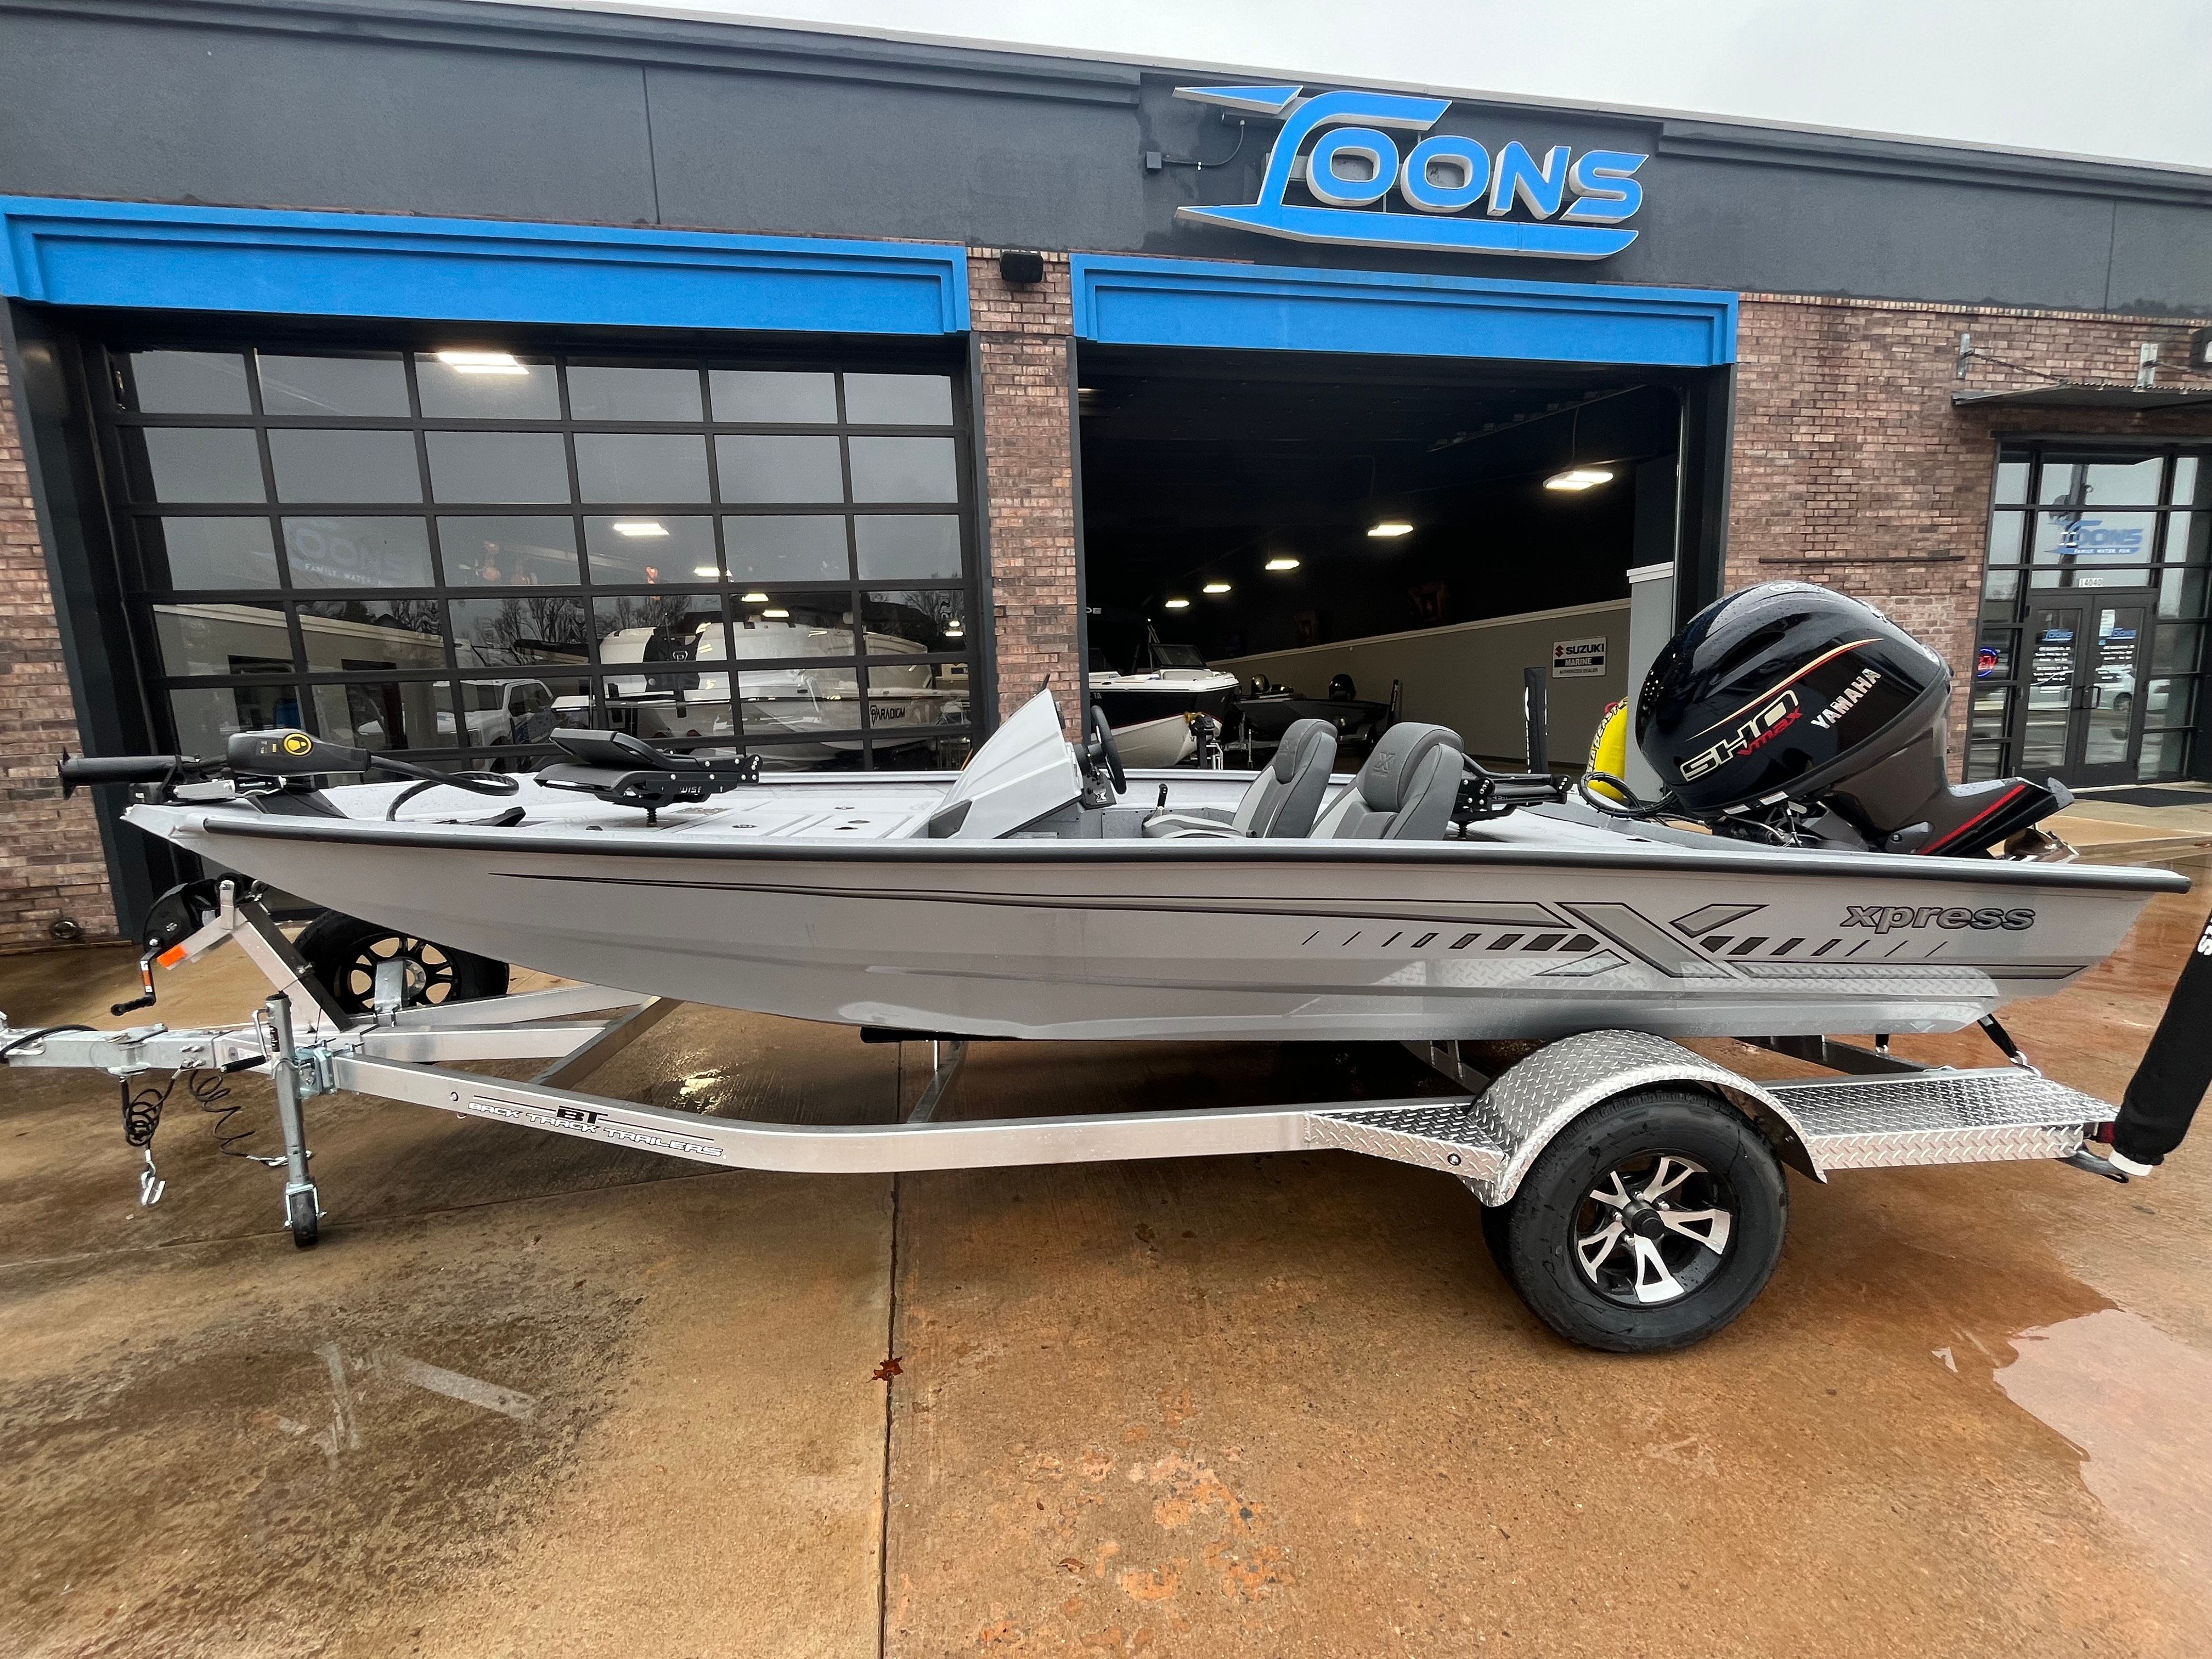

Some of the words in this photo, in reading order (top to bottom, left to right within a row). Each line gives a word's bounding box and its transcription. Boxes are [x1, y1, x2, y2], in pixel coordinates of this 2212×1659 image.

[1565, 658, 1592, 666] MARINE
[1566, 644, 1604, 655] SUZUKI
[1810, 668, 1881, 729] YAMAHA
[870, 705, 905, 726] PARADIGM
[1680, 690, 1799, 782] SHO
[1839, 905, 2036, 934] xpress
[556, 1105, 608, 1124] BT
[469, 1102, 523, 1118] BACK
[526, 1113, 601, 1133] TRACK
[603, 1127, 724, 1157] TRAILERS
